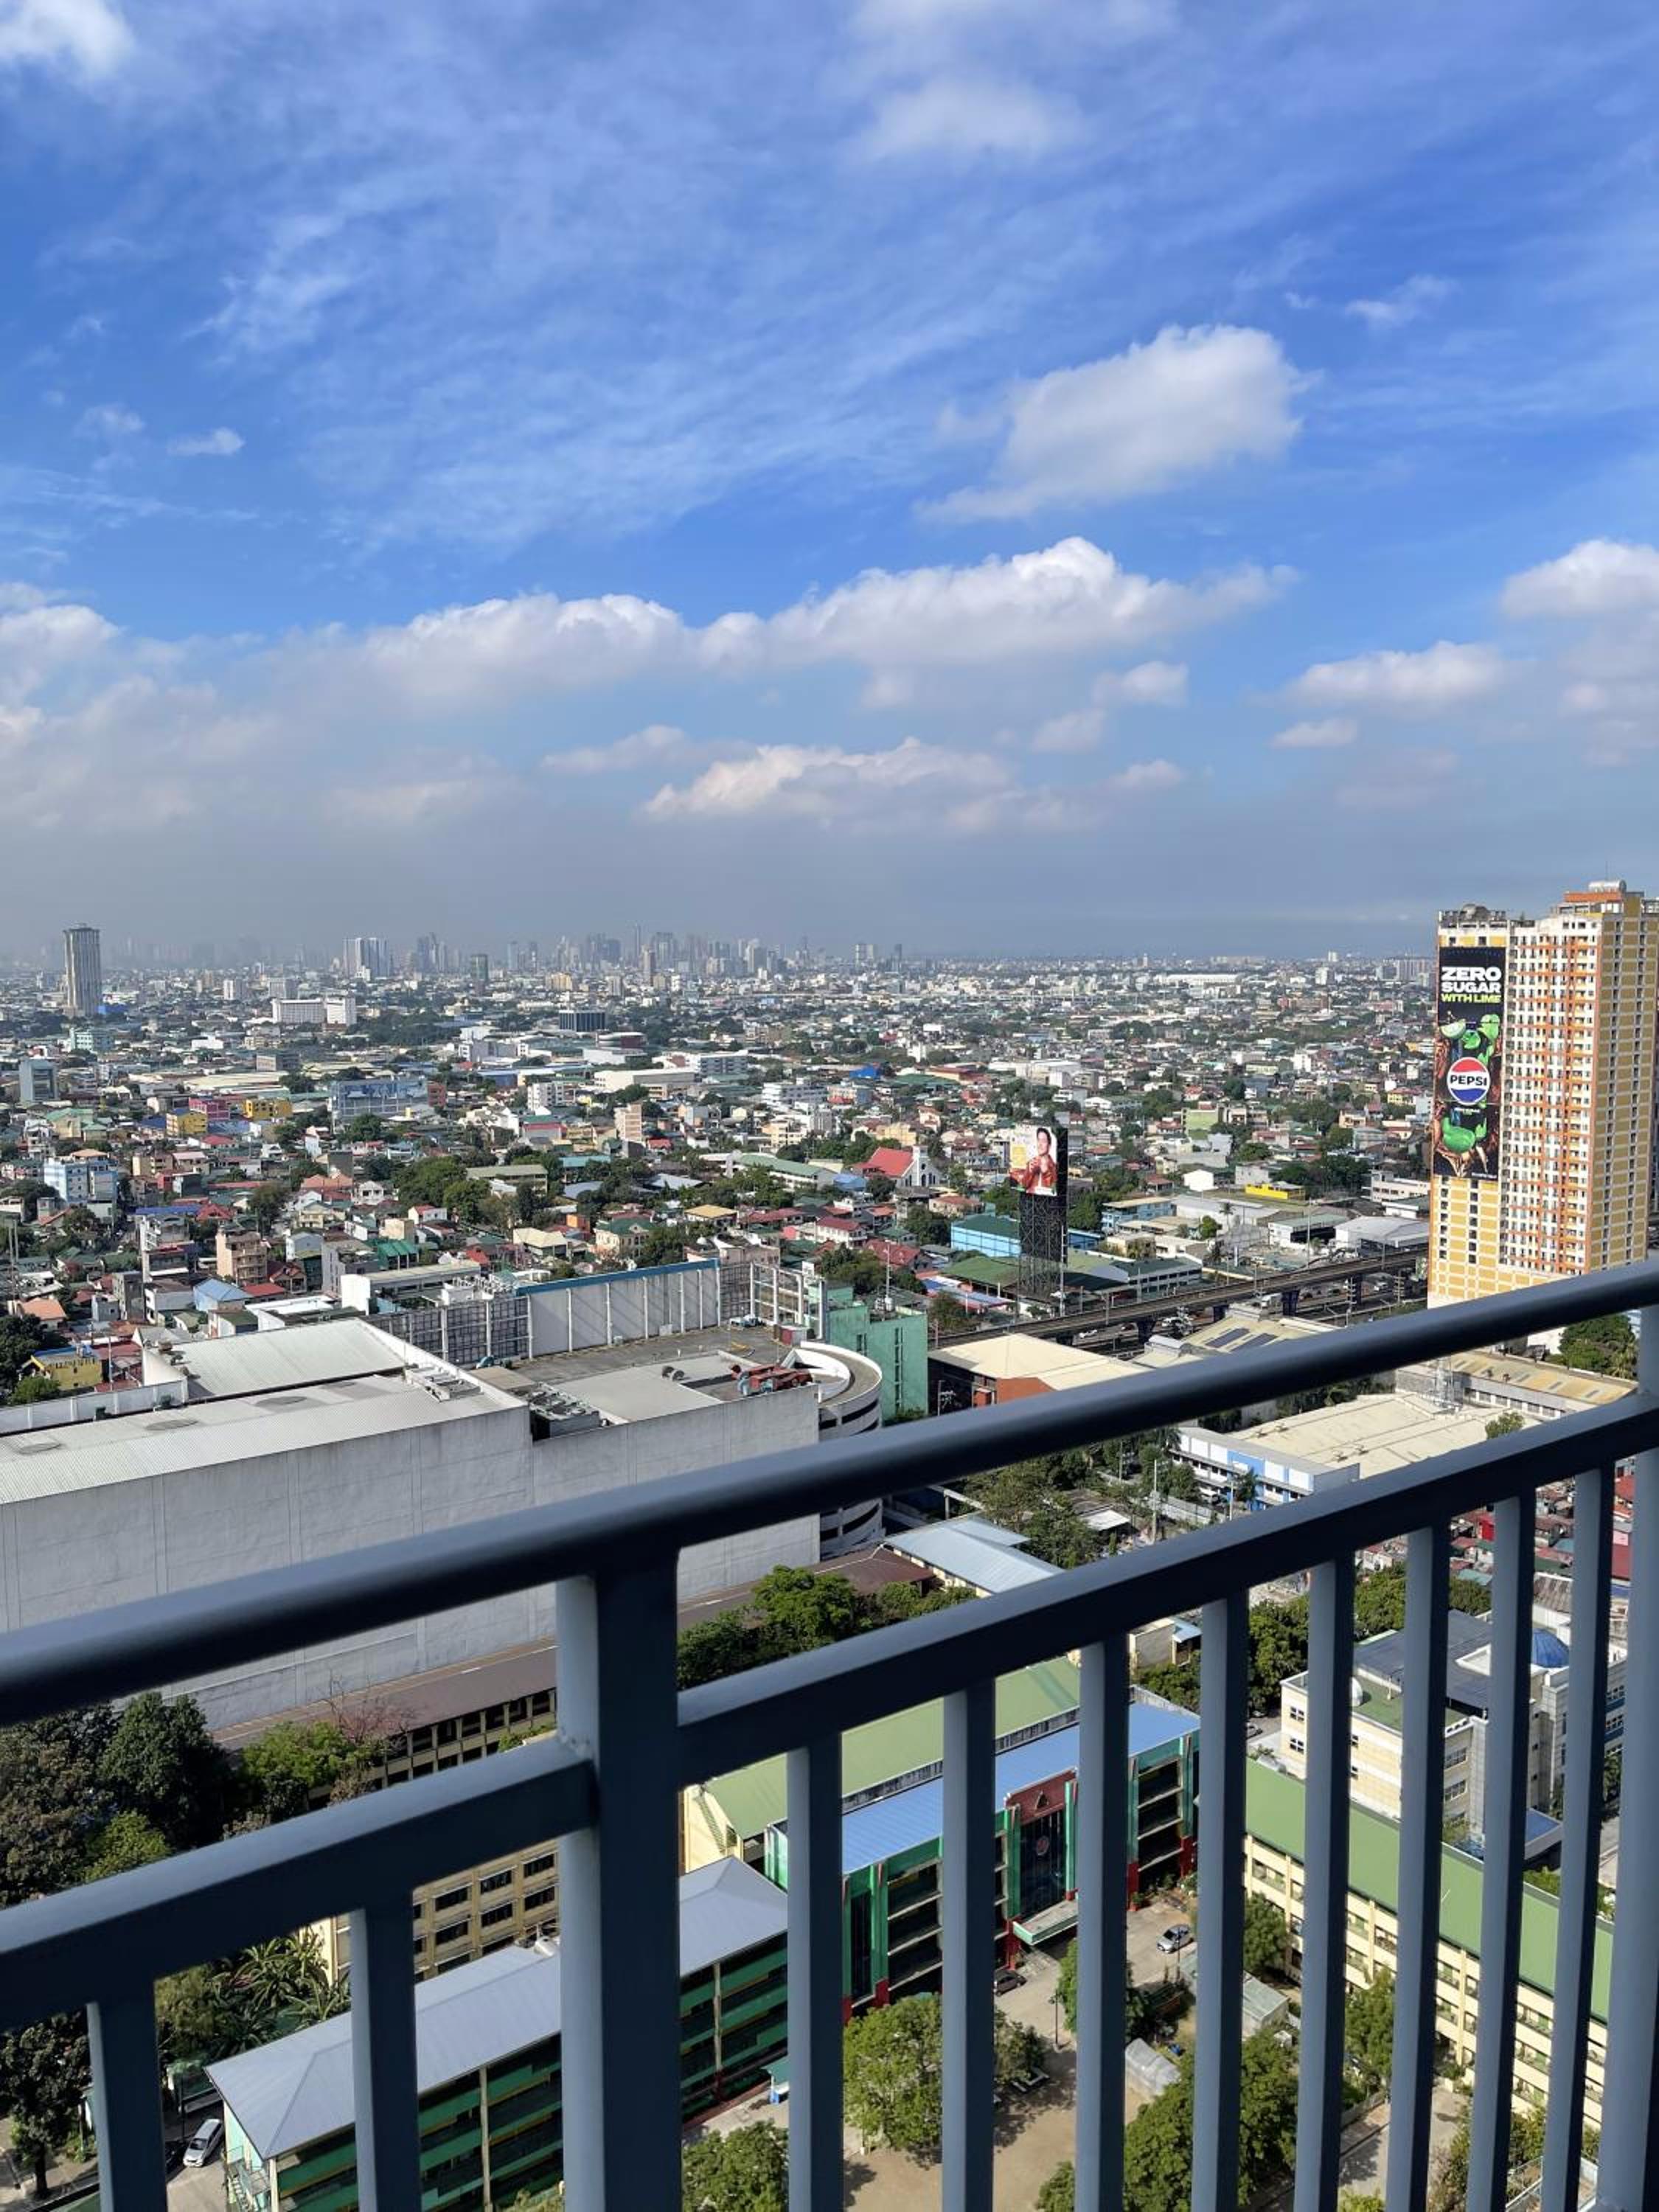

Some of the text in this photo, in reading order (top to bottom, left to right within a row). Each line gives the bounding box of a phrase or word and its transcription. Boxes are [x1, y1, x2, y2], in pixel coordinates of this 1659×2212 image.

[1441, 967, 1502, 981] ZERO
[1441, 981, 1501, 993] SUGAR
[1441, 993, 1501, 1004] WITH LIME
[1450, 1074, 1487, 1086] PEPSI
